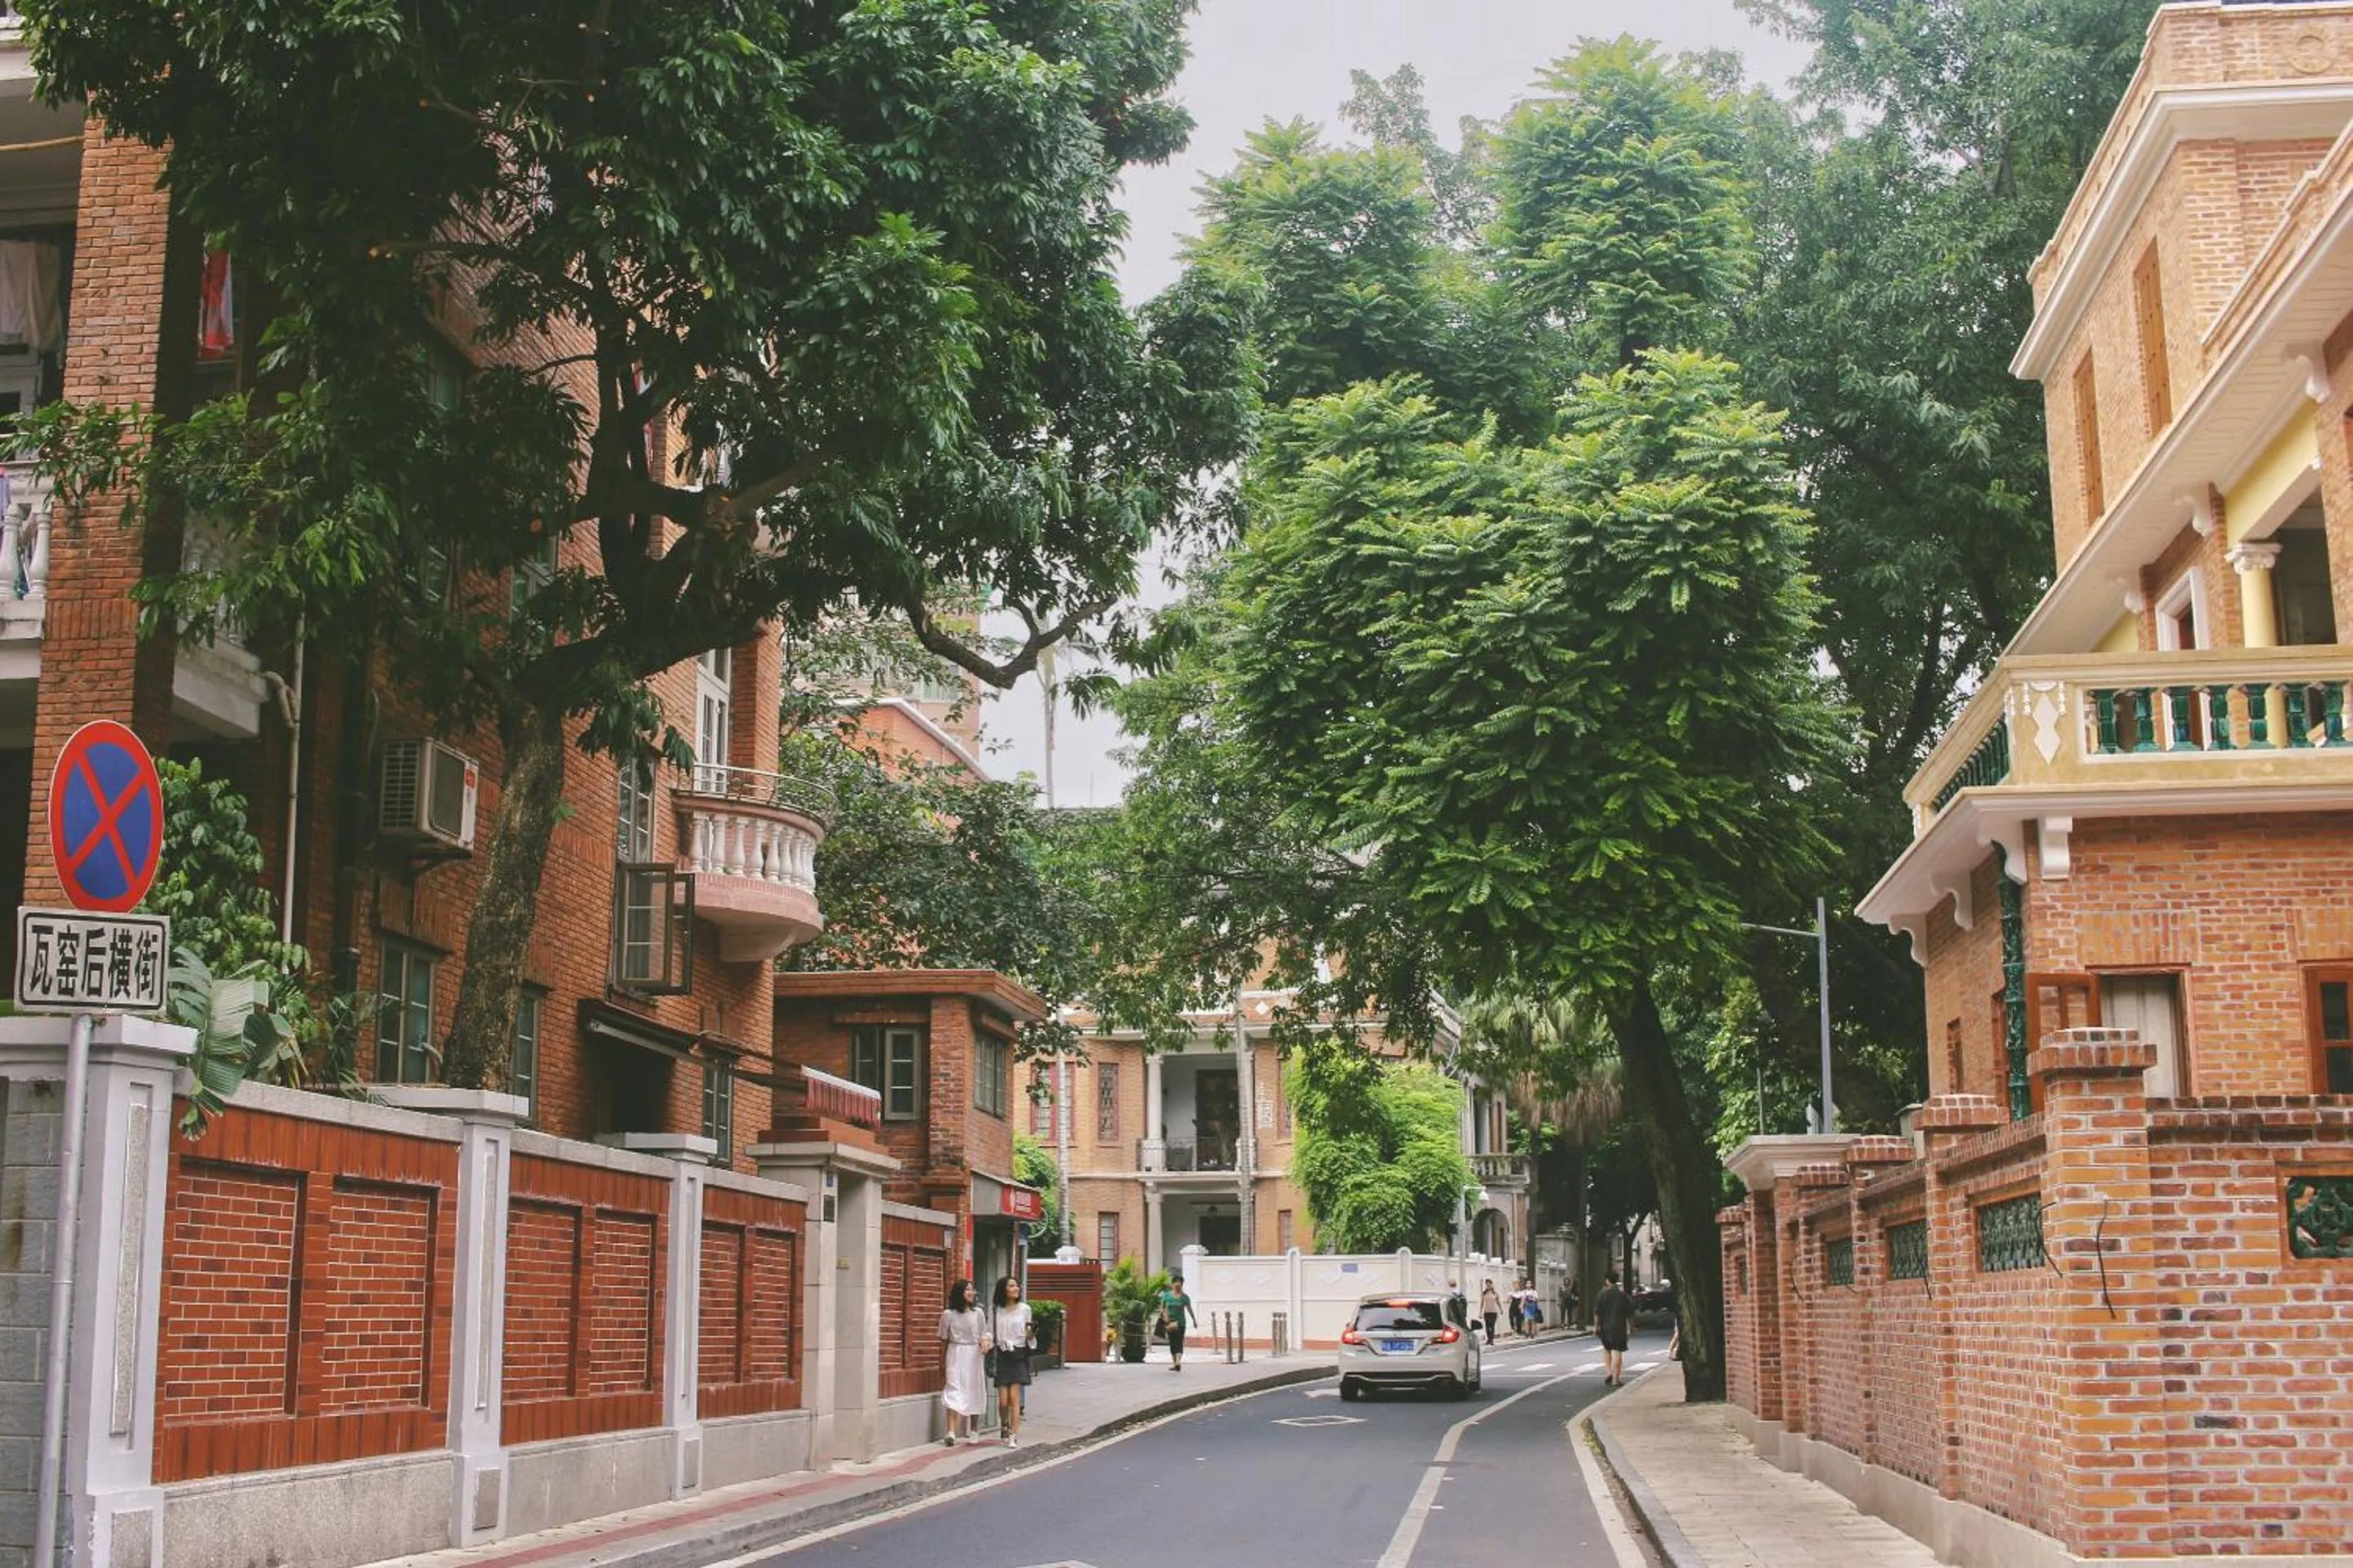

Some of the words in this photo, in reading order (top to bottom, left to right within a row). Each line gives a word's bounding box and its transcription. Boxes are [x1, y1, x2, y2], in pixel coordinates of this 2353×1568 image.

[29, 923, 158, 999] 瓦窑后横街
